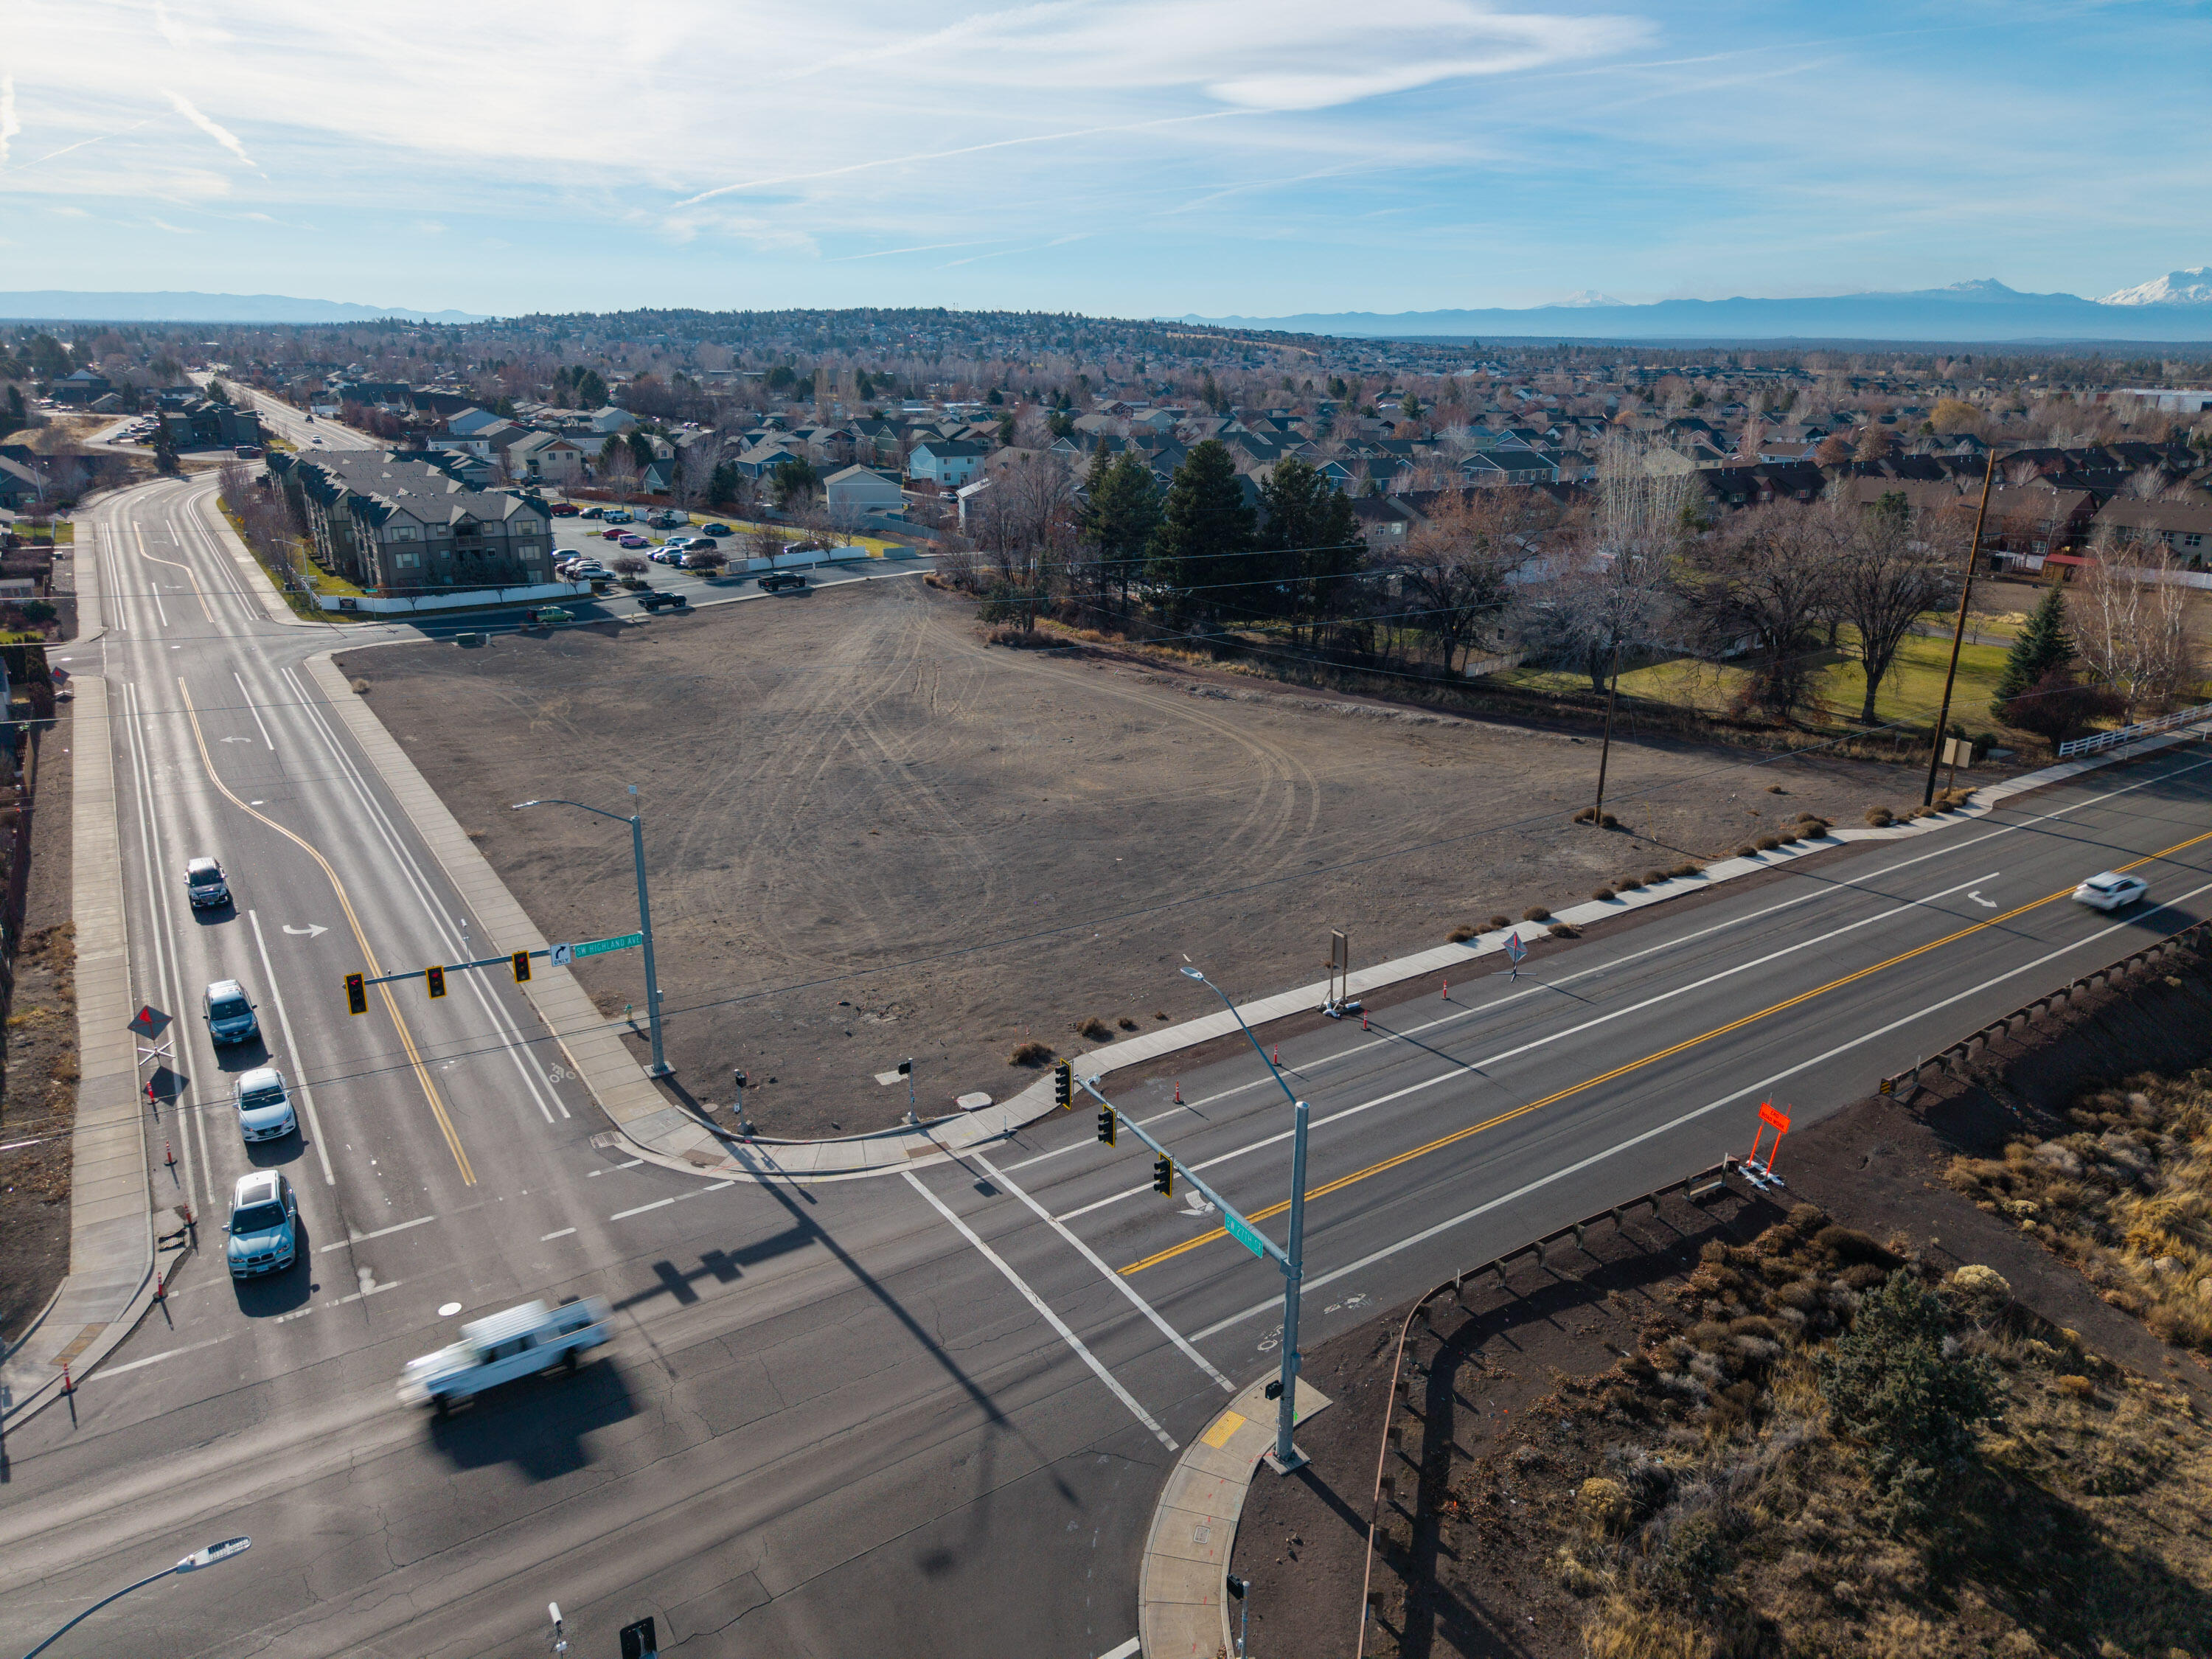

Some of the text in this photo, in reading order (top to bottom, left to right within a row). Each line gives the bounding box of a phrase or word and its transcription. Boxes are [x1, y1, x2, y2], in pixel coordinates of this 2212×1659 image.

[577, 936, 641, 956] SW HIGHLAND AVE
[1761, 1111, 1784, 1129] ROAD WORK
[1770, 1110, 1779, 1119] END
[1227, 1217, 1262, 1252] SW 27TH ST
